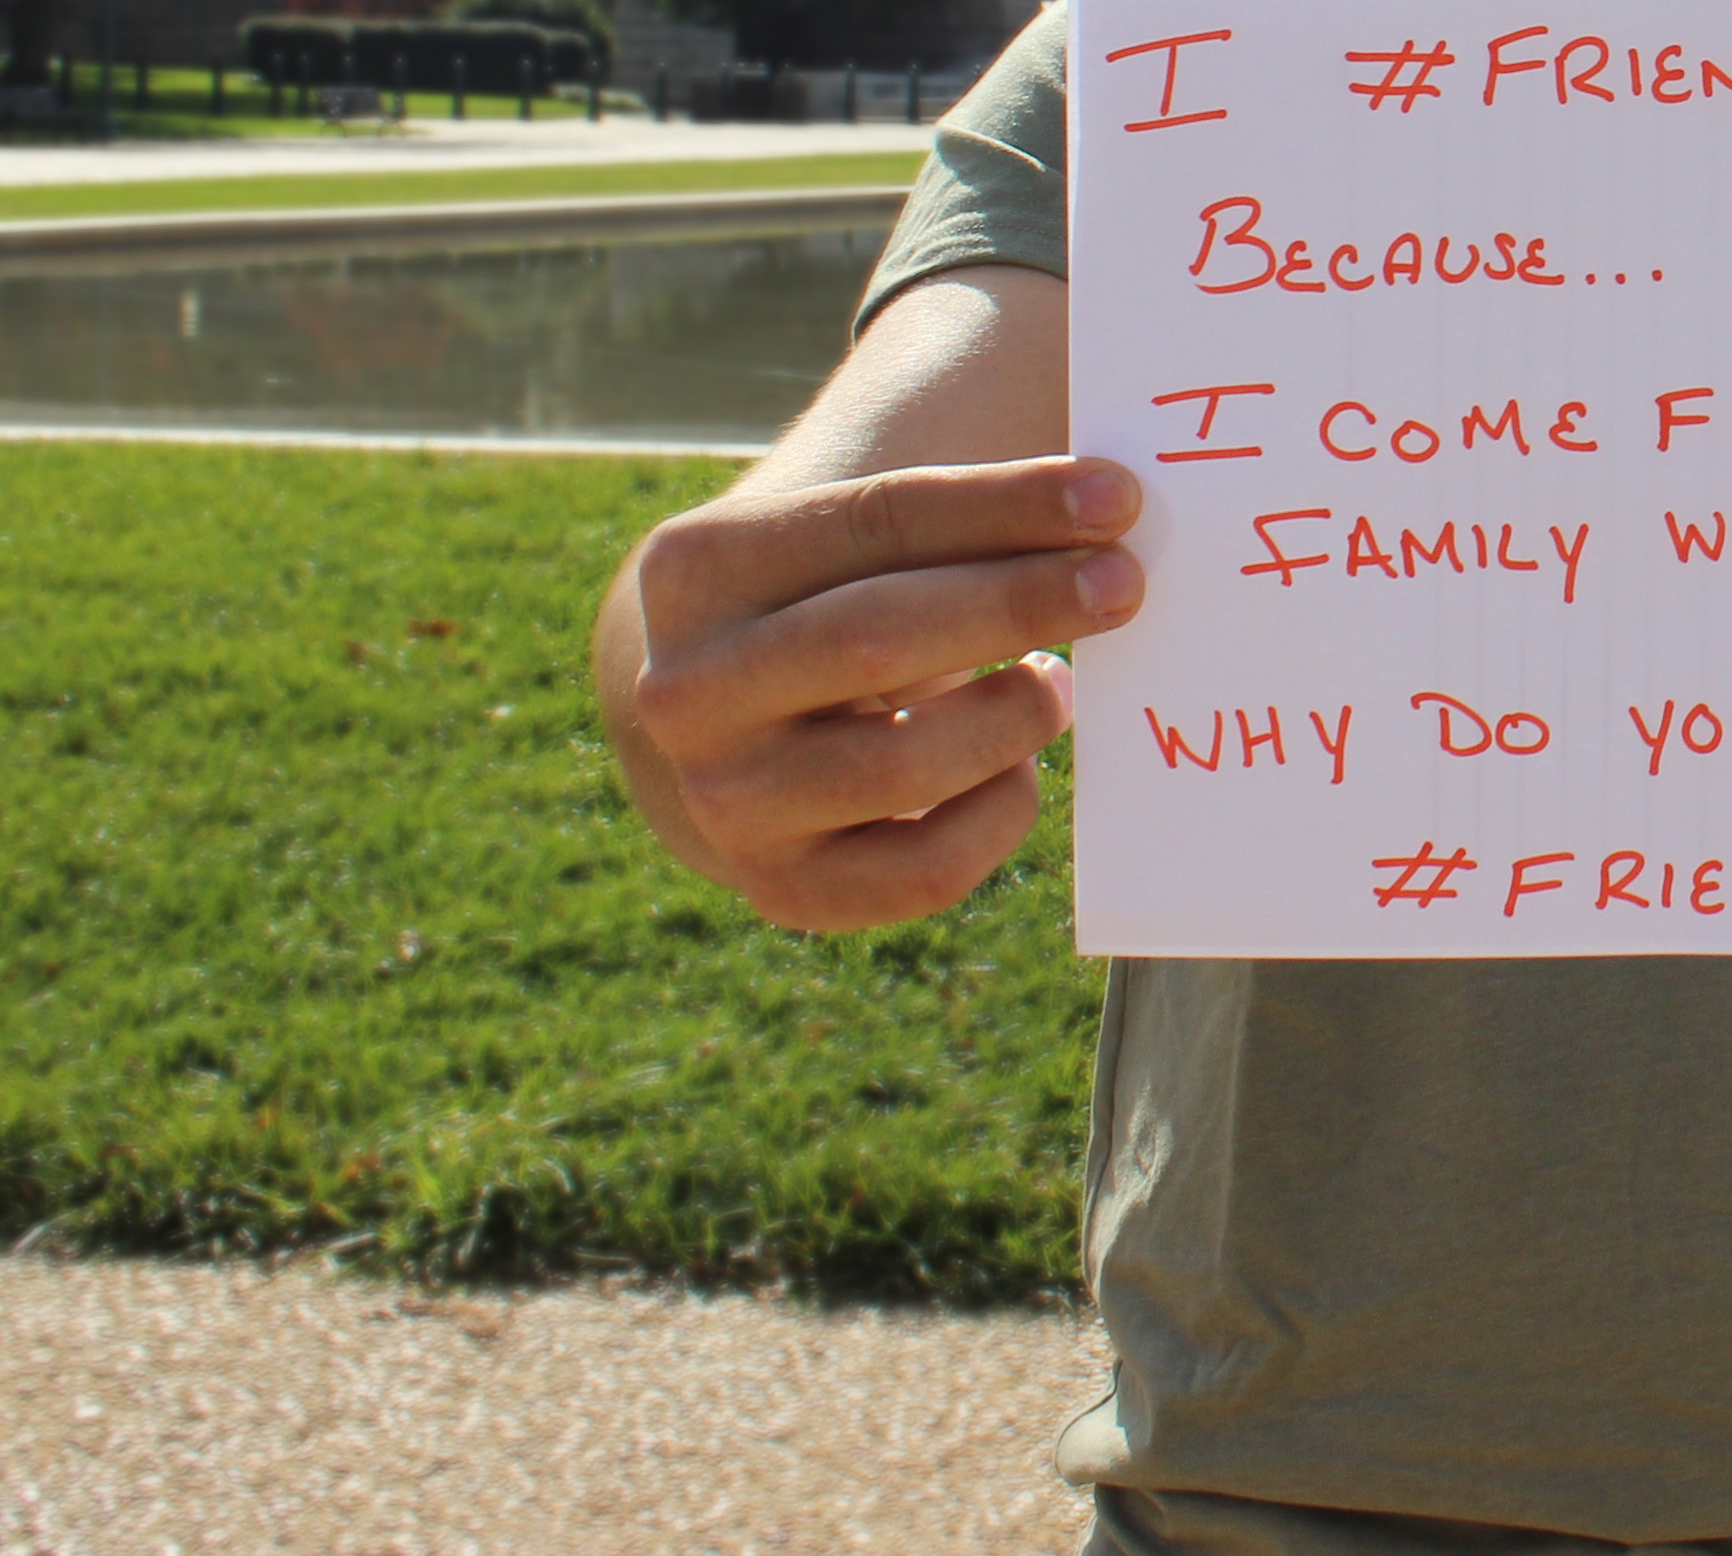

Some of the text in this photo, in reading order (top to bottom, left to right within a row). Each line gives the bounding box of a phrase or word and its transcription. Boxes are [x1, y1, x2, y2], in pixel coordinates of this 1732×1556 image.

[1107, 29, 1233, 132] I
[1152, 383, 1276, 463] I
[1320, 398, 1599, 462] COME
[1241, 508, 1590, 603] FAMILY
[1144, 701, 1354, 785] WHY
[1410, 691, 1551, 757] DO
